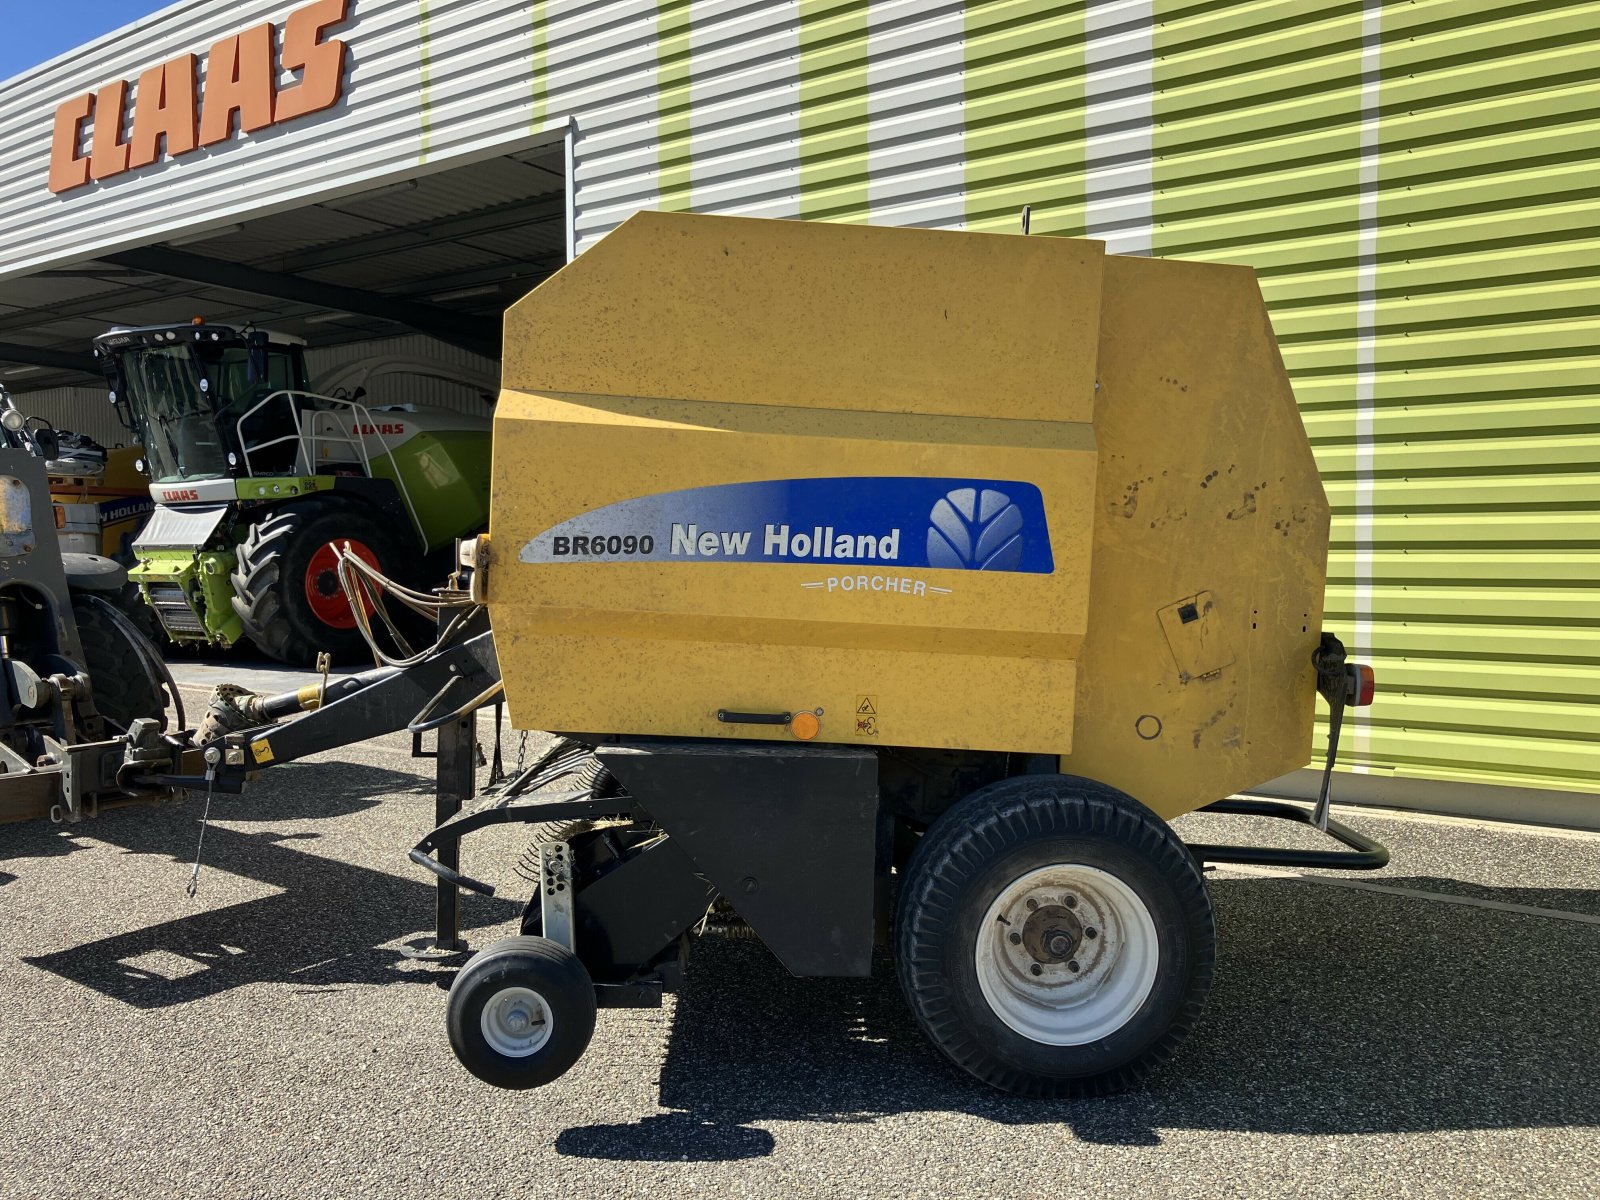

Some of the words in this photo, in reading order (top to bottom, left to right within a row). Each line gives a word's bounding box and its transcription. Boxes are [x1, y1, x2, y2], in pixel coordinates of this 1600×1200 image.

[48, 0, 346, 194] CLAAS
[163, 490, 199, 501] CLAAS
[109, 501, 154, 520] HOLLAN
[552, 535, 654, 556] BR6090
[671, 522, 751, 556] New
[763, 523, 900, 560] Holland
[827, 575, 927, 597] PORCHER
